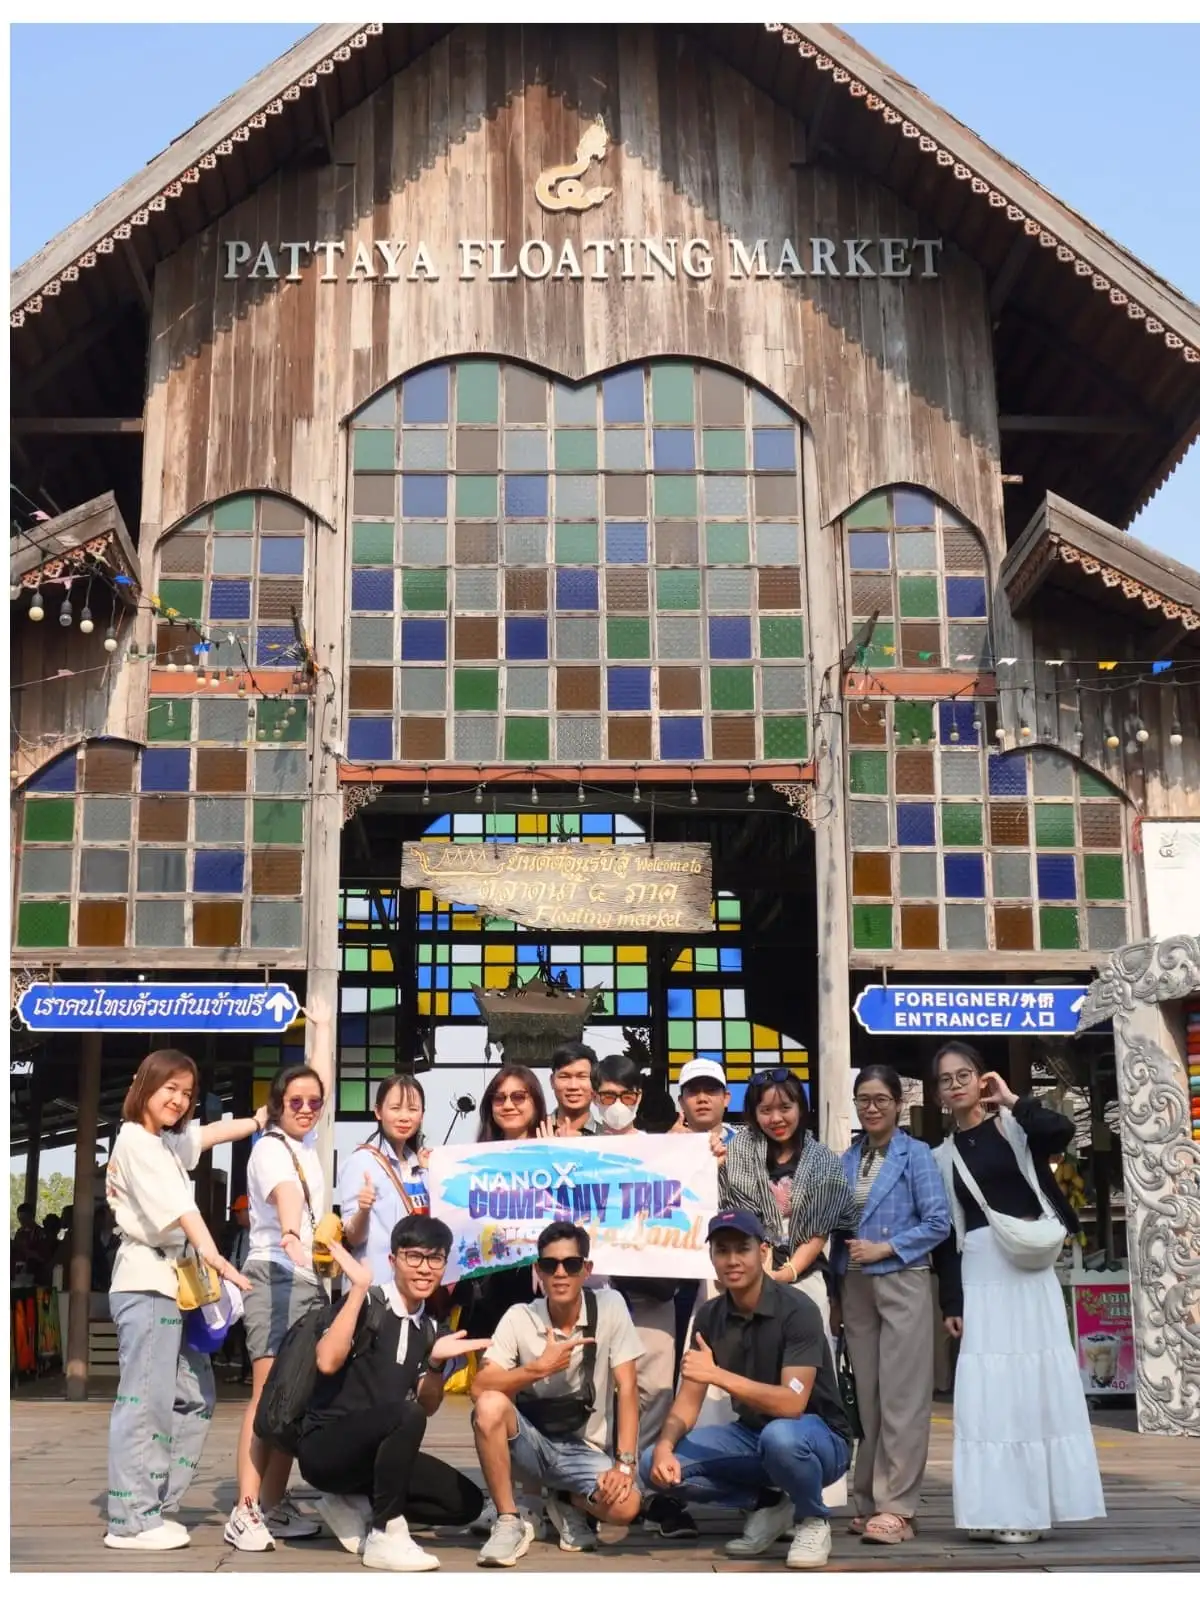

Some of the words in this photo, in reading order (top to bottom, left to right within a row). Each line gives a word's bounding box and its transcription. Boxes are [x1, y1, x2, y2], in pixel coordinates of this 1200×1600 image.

[224, 238, 440, 283] PATTAYA
[459, 237, 714, 282] FLOATING
[727, 236, 943, 280] MARKET
[527, 905, 613, 929] Floating
[616, 908, 684, 928] market
[895, 1012, 1012, 1028] ENTRANCE/
[469, 1161, 577, 1192] NANOX
[468, 1182, 610, 1224] COMPANY
[618, 1180, 682, 1220] TRIP
